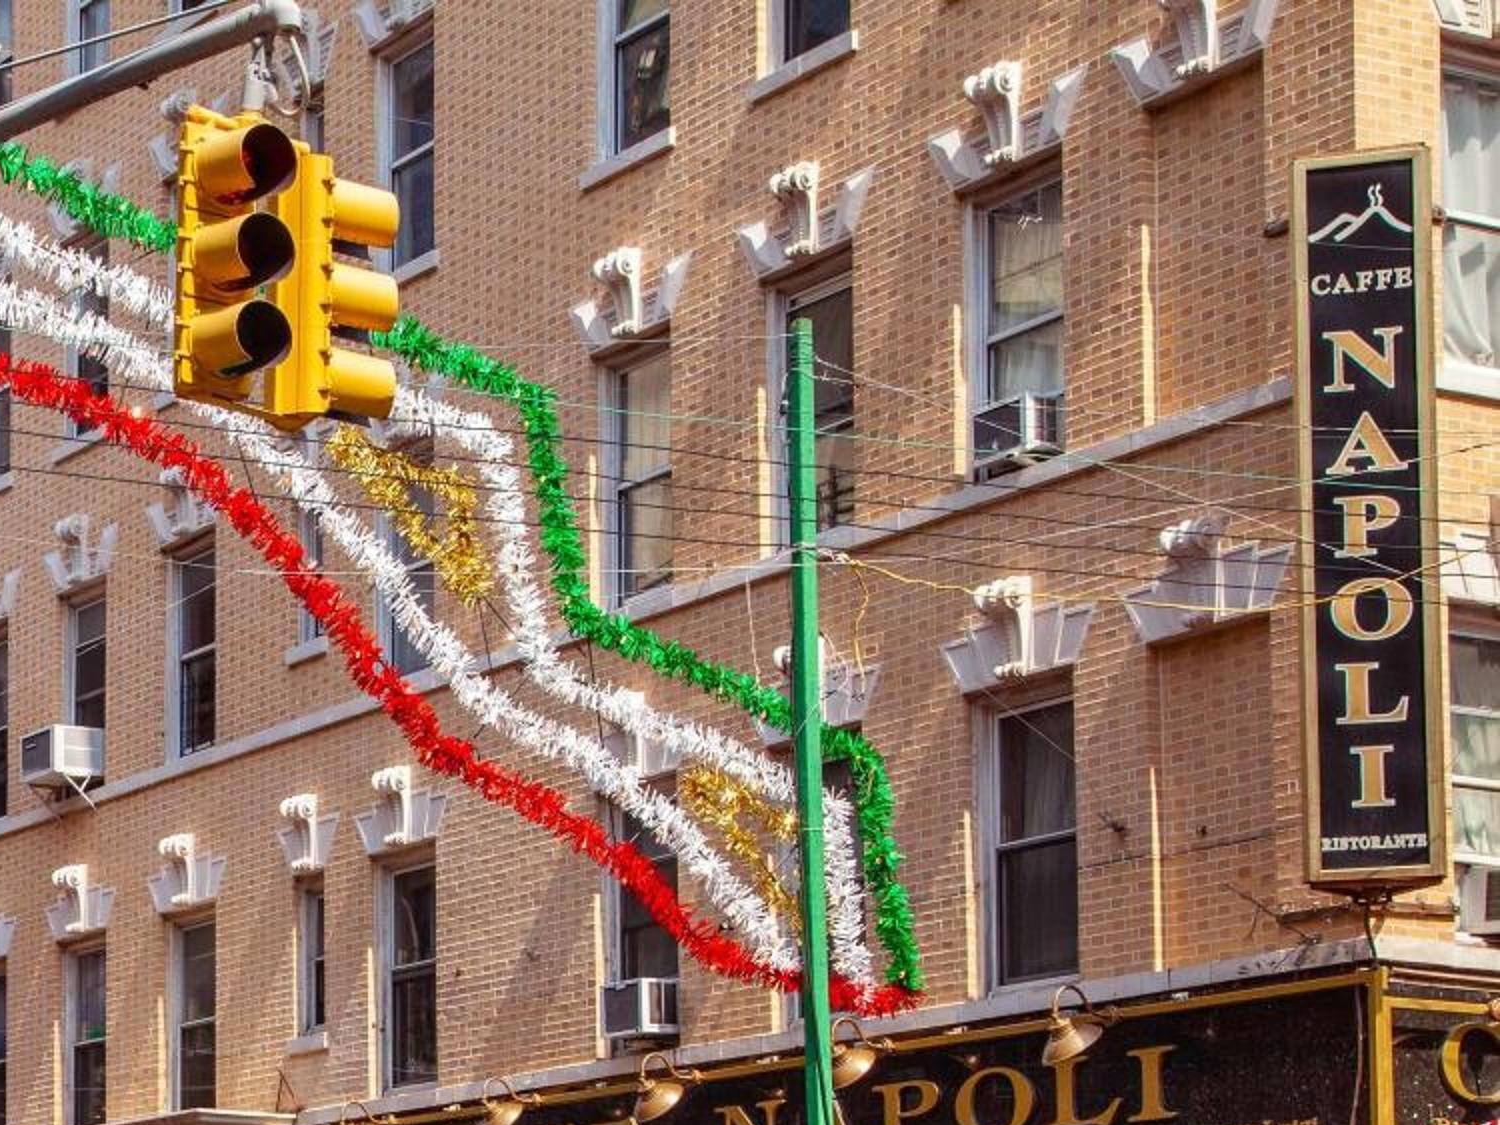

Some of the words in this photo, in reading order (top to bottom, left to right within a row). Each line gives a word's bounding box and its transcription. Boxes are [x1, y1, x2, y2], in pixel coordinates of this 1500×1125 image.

[1311, 266, 1412, 296] CAFFE
[1322, 326, 1414, 808] NAPOLI
[1321, 833, 1428, 851] RISTORANTE
